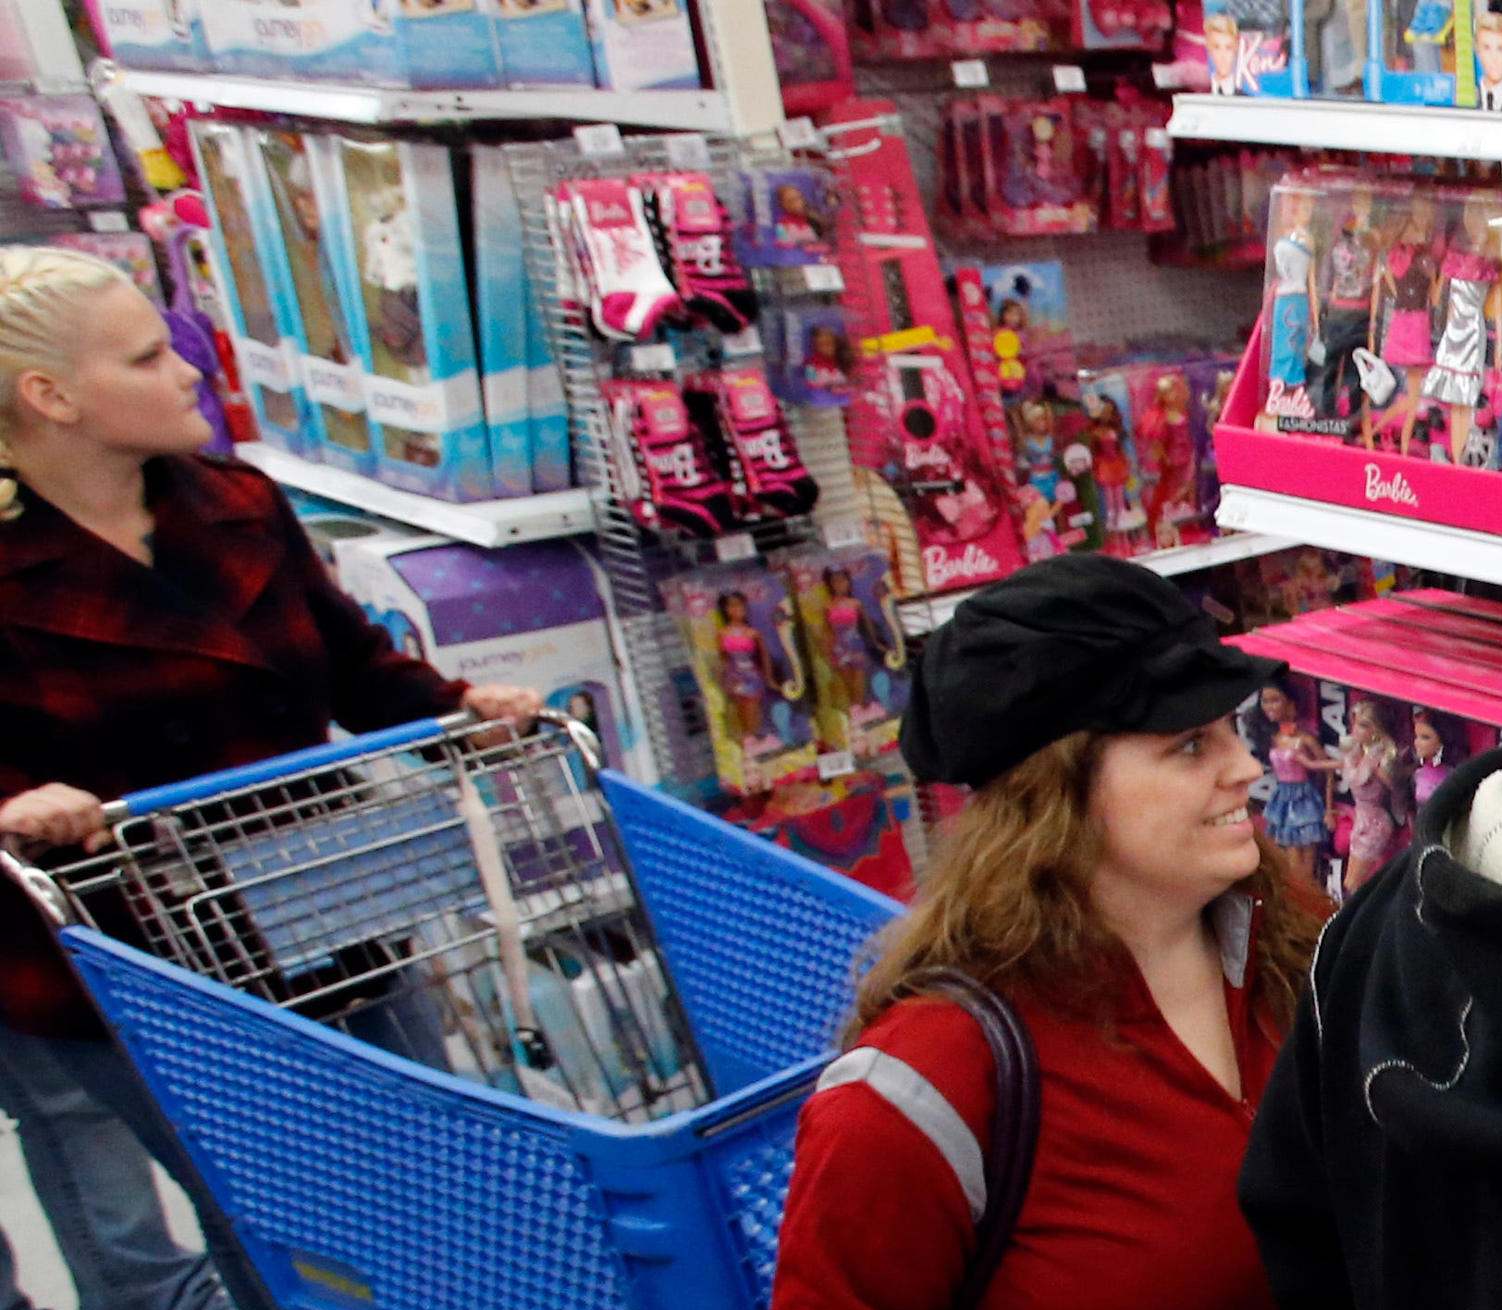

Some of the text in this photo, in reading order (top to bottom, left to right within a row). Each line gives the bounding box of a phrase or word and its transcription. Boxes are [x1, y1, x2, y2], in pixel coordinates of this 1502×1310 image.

[1235, 34, 1287, 92] Ken
[1265, 379, 1315, 418] Barbie
[1278, 416, 1349, 434] FASHIONISTAS
[1365, 463, 1419, 507] Barbie
[922, 545, 998, 587] Barbie
